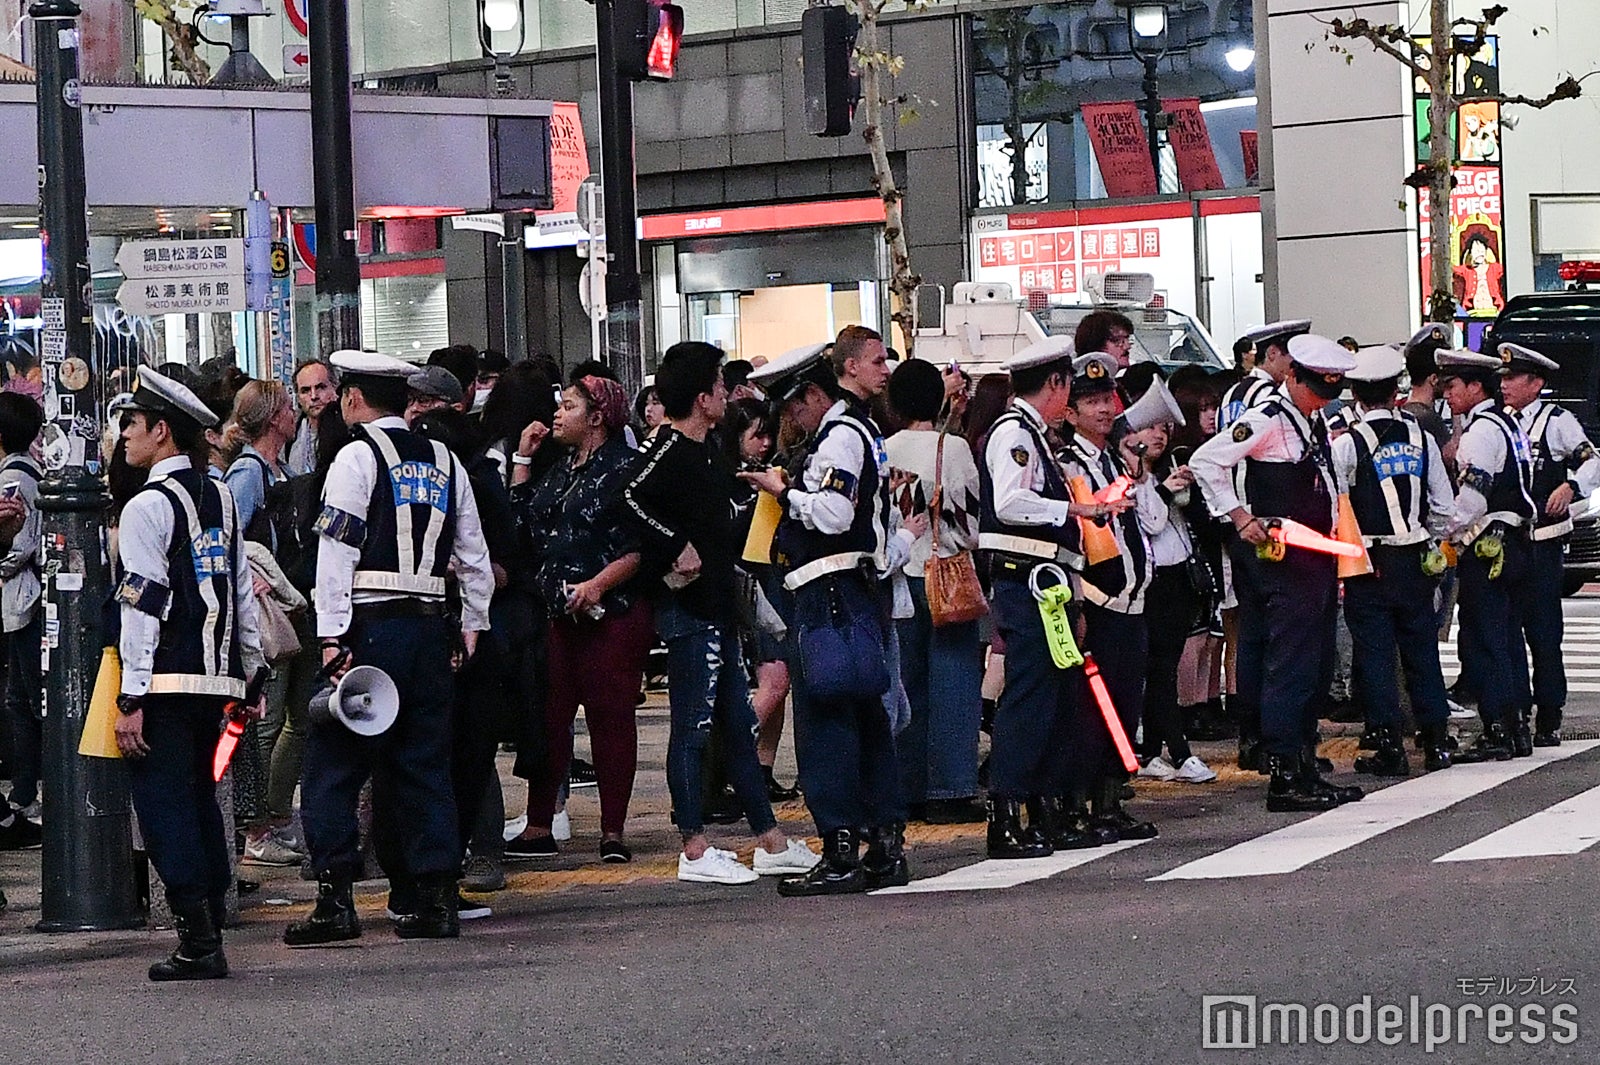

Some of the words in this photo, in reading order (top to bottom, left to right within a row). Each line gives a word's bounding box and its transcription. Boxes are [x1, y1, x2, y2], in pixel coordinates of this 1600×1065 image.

[1474, 170, 1500, 196] 6F
[1457, 196, 1500, 216] PIECE
[143, 245, 228, 262] 鍋島松濤公園
[982, 237, 1073, 264] 住宅ローン
[1083, 231, 1158, 255] 資産運用
[210, 262, 228, 271] PARK
[271, 249, 285, 271] 6
[145, 282, 230, 299] 松濤美術館
[145, 300, 170, 309] SHOTO
[171, 300, 200, 308] MUSEUM
[203, 299, 213, 307] OF
[215, 299, 230, 307] ART
[1373, 444, 1422, 463] POLICE
[391, 464, 449, 490] POLICE
